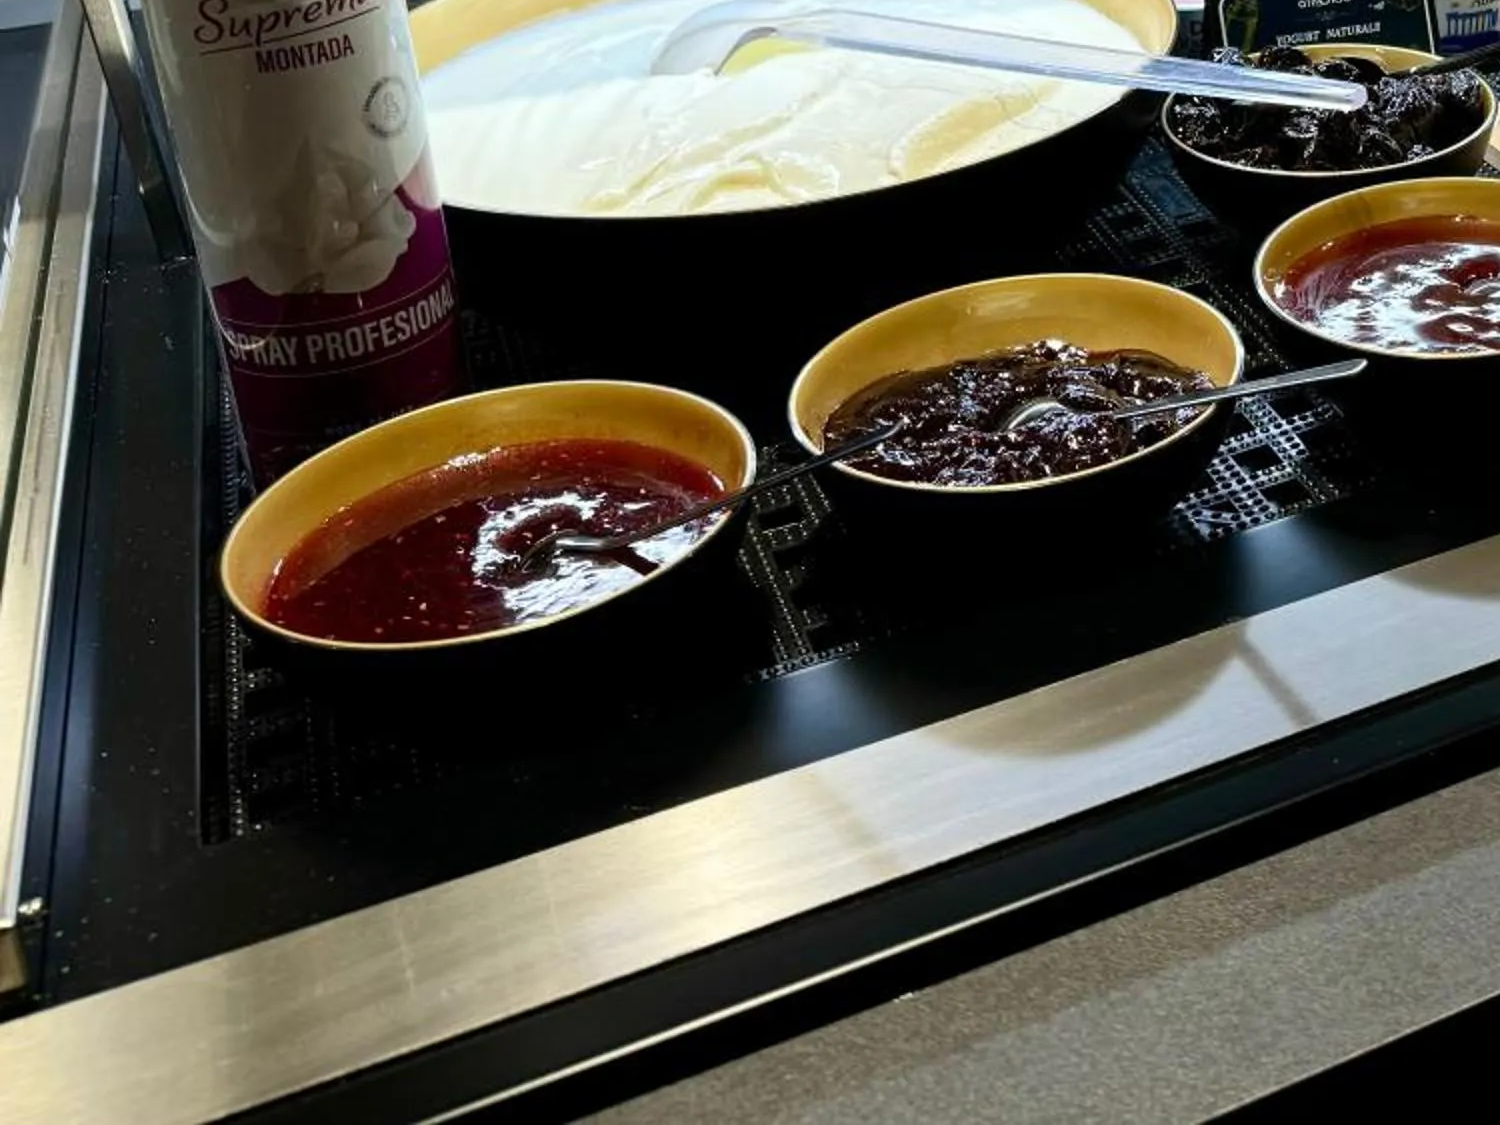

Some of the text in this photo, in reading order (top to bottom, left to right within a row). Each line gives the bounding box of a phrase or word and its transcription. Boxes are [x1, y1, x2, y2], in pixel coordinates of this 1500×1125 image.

[1326, 22, 1381, 40] NATURALE
[256, 34, 354, 73] MONTADA
[227, 330, 299, 367] SPRAY
